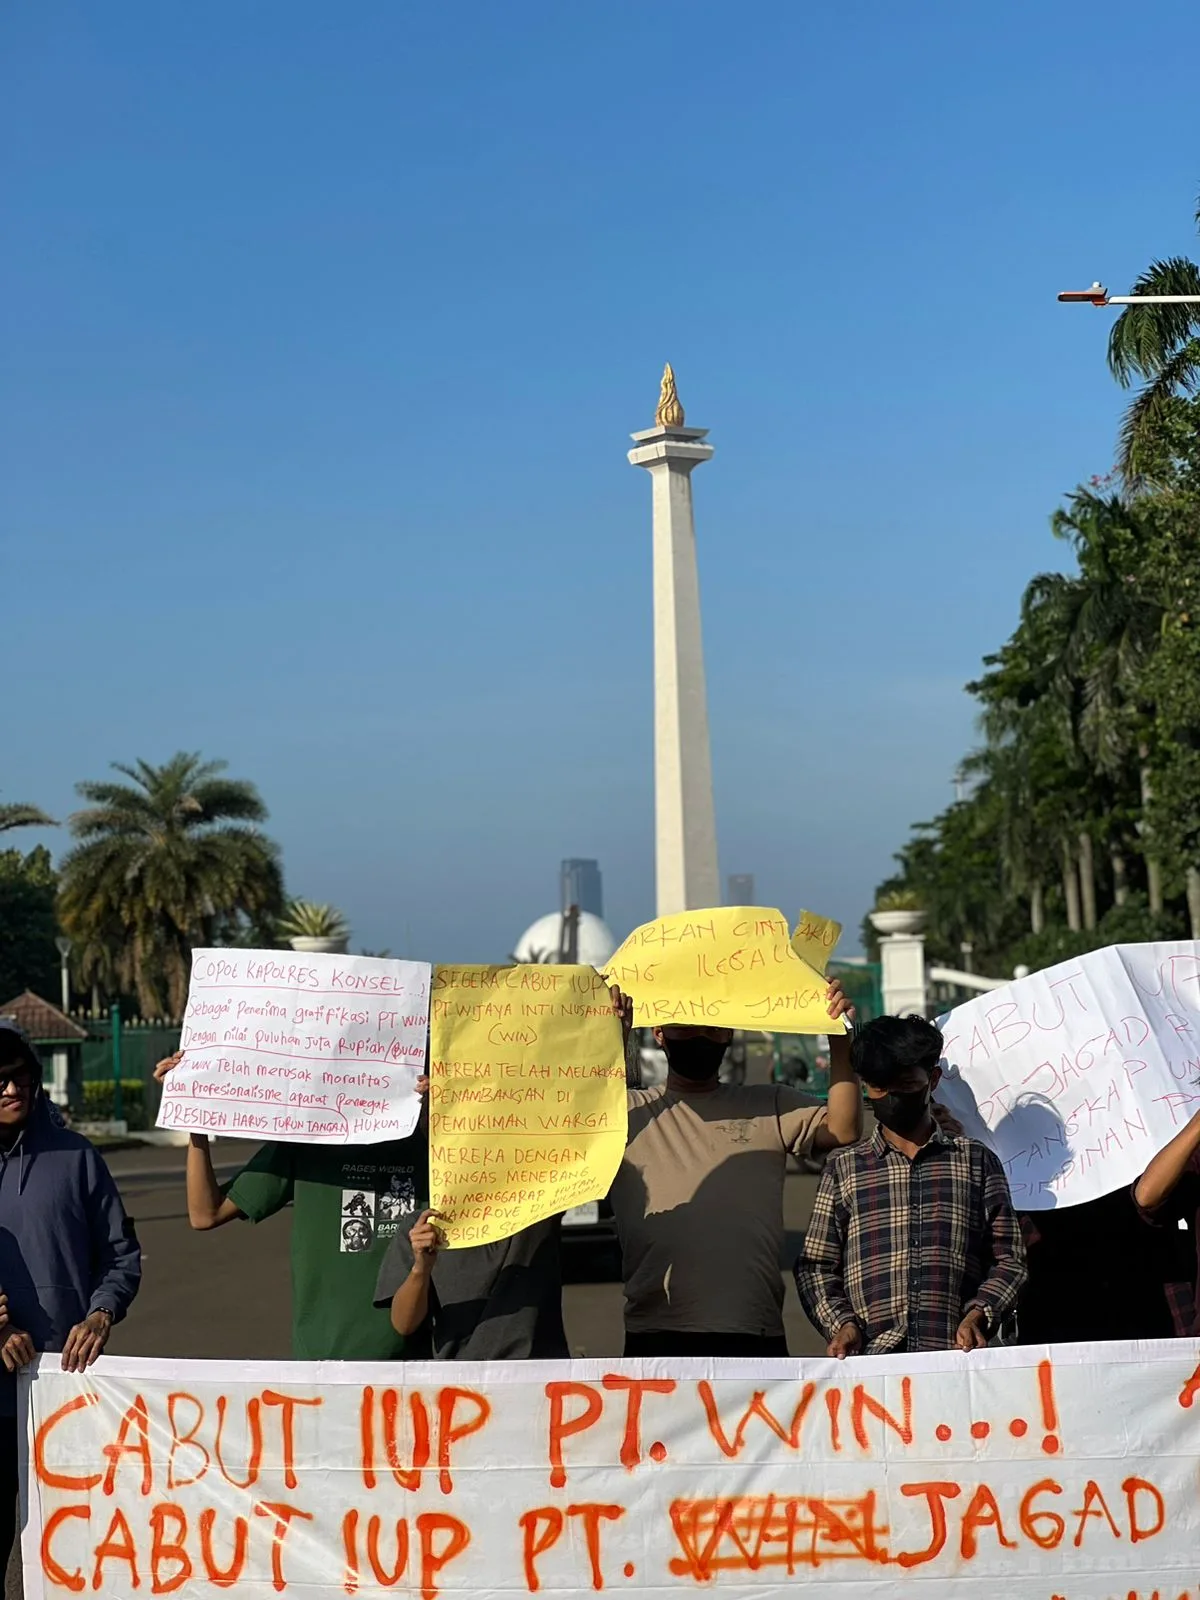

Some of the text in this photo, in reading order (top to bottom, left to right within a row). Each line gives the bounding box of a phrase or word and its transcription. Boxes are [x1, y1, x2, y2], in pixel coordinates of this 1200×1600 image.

[246, 960, 320, 988] KAPOLRES
[434, 969, 501, 990] SEGERA
[506, 970, 566, 991] CABUT
[600, 962, 662, 983] ANG
[188, 996, 231, 1019] Sebagai
[456, 1002, 512, 1022] WIJAYA
[521, 1003, 555, 1016] INTI
[488, 1023, 539, 1046] (WIN)
[431, 1061, 491, 1079] MEREKA
[496, 1063, 551, 1079] TELAH
[166, 1077, 187, 1093] dan
[557, 1089, 571, 1104] DI
[163, 1102, 348, 1134] PRESIDEN HARUS TURUN TANGAN
[430, 1112, 528, 1133] PEMUKIMAN
[431, 1145, 588, 1164] MEREKA DENGAN
[341, 1164, 415, 1174] RAGES WORLD
[432, 1166, 590, 1186] BRINGAS MENEBANG
[432, 1192, 458, 1206] DAN
[443, 1224, 490, 1241] ESISIR
[34, 1388, 324, 1497] CABUT
[360, 1384, 492, 1495] IUP
[545, 1372, 677, 1488] PT.
[40, 1500, 314, 1595] CABUT
[342, 1508, 472, 1600] IUP
[518, 1502, 635, 1592] PT.
[899, 1475, 1166, 1569] JAGAD
